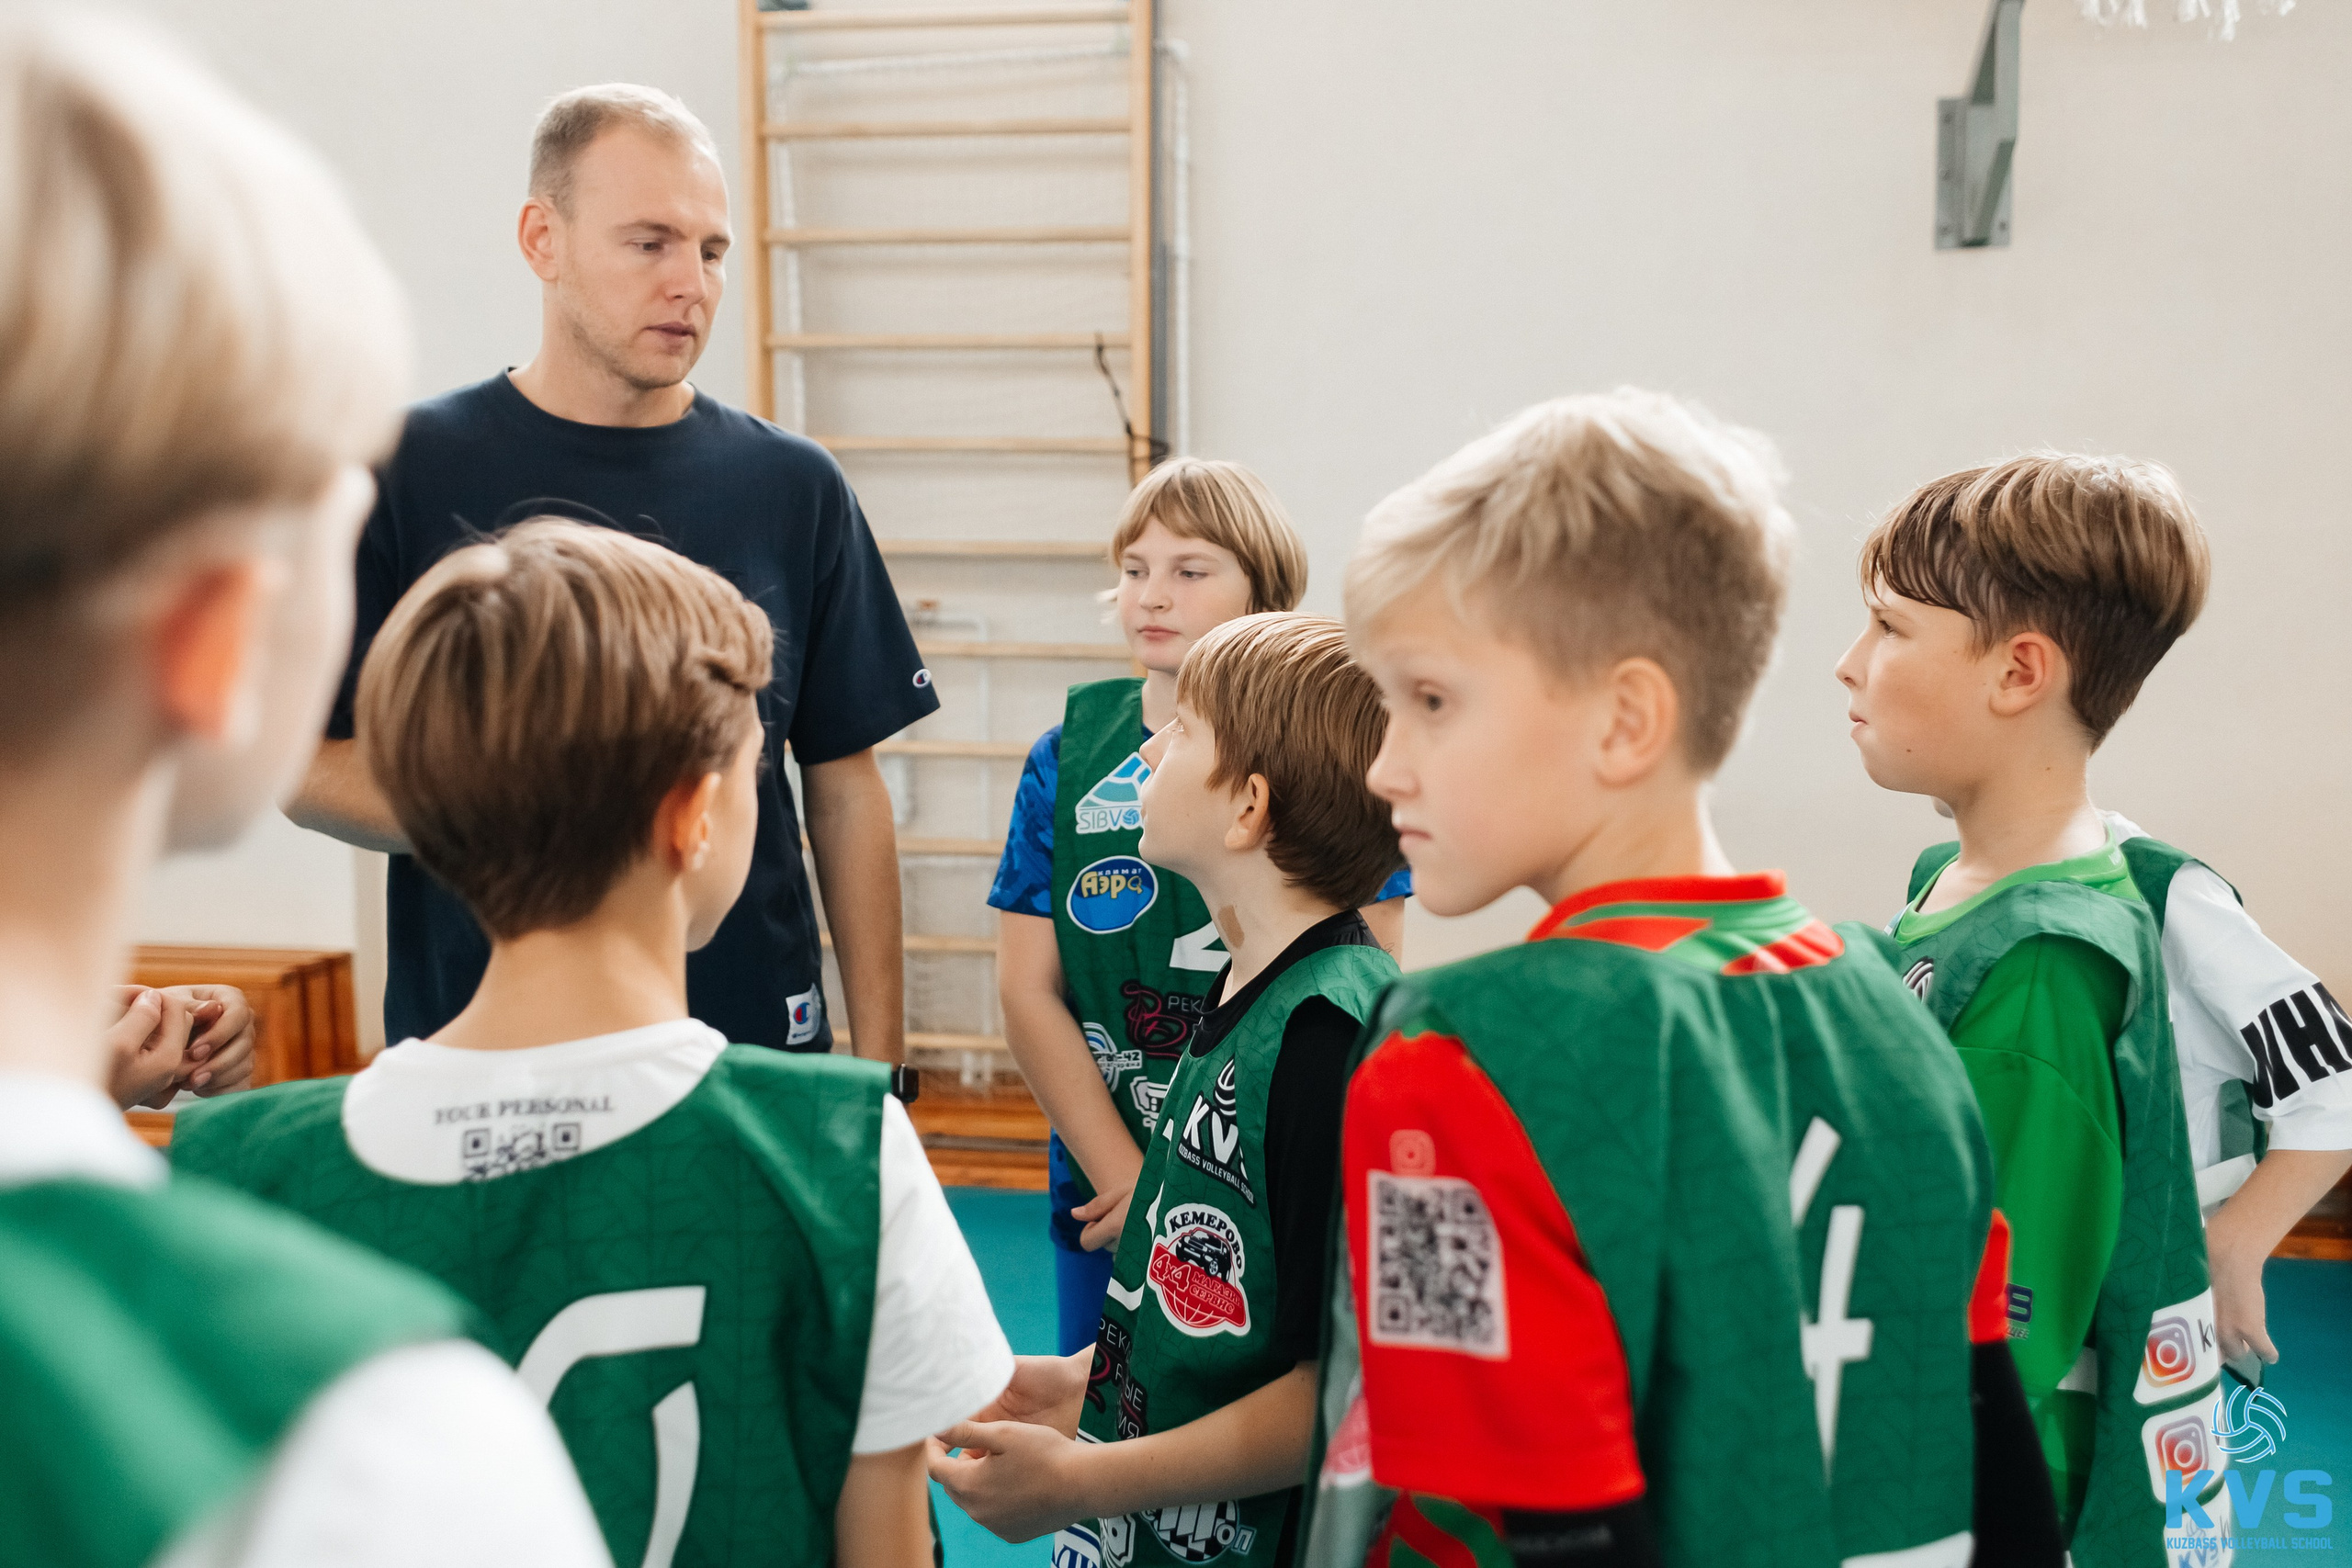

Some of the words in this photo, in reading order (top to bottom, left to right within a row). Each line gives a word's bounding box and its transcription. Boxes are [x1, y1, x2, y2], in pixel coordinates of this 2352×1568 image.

[1182, 1094, 1249, 1180] KV
[1202, 1158, 1240, 1189] VOLLEYBALL
[1169, 1211, 1242, 1269] КЕМЕРОВО
[1189, 1283, 1235, 1314] СЕРВИС
